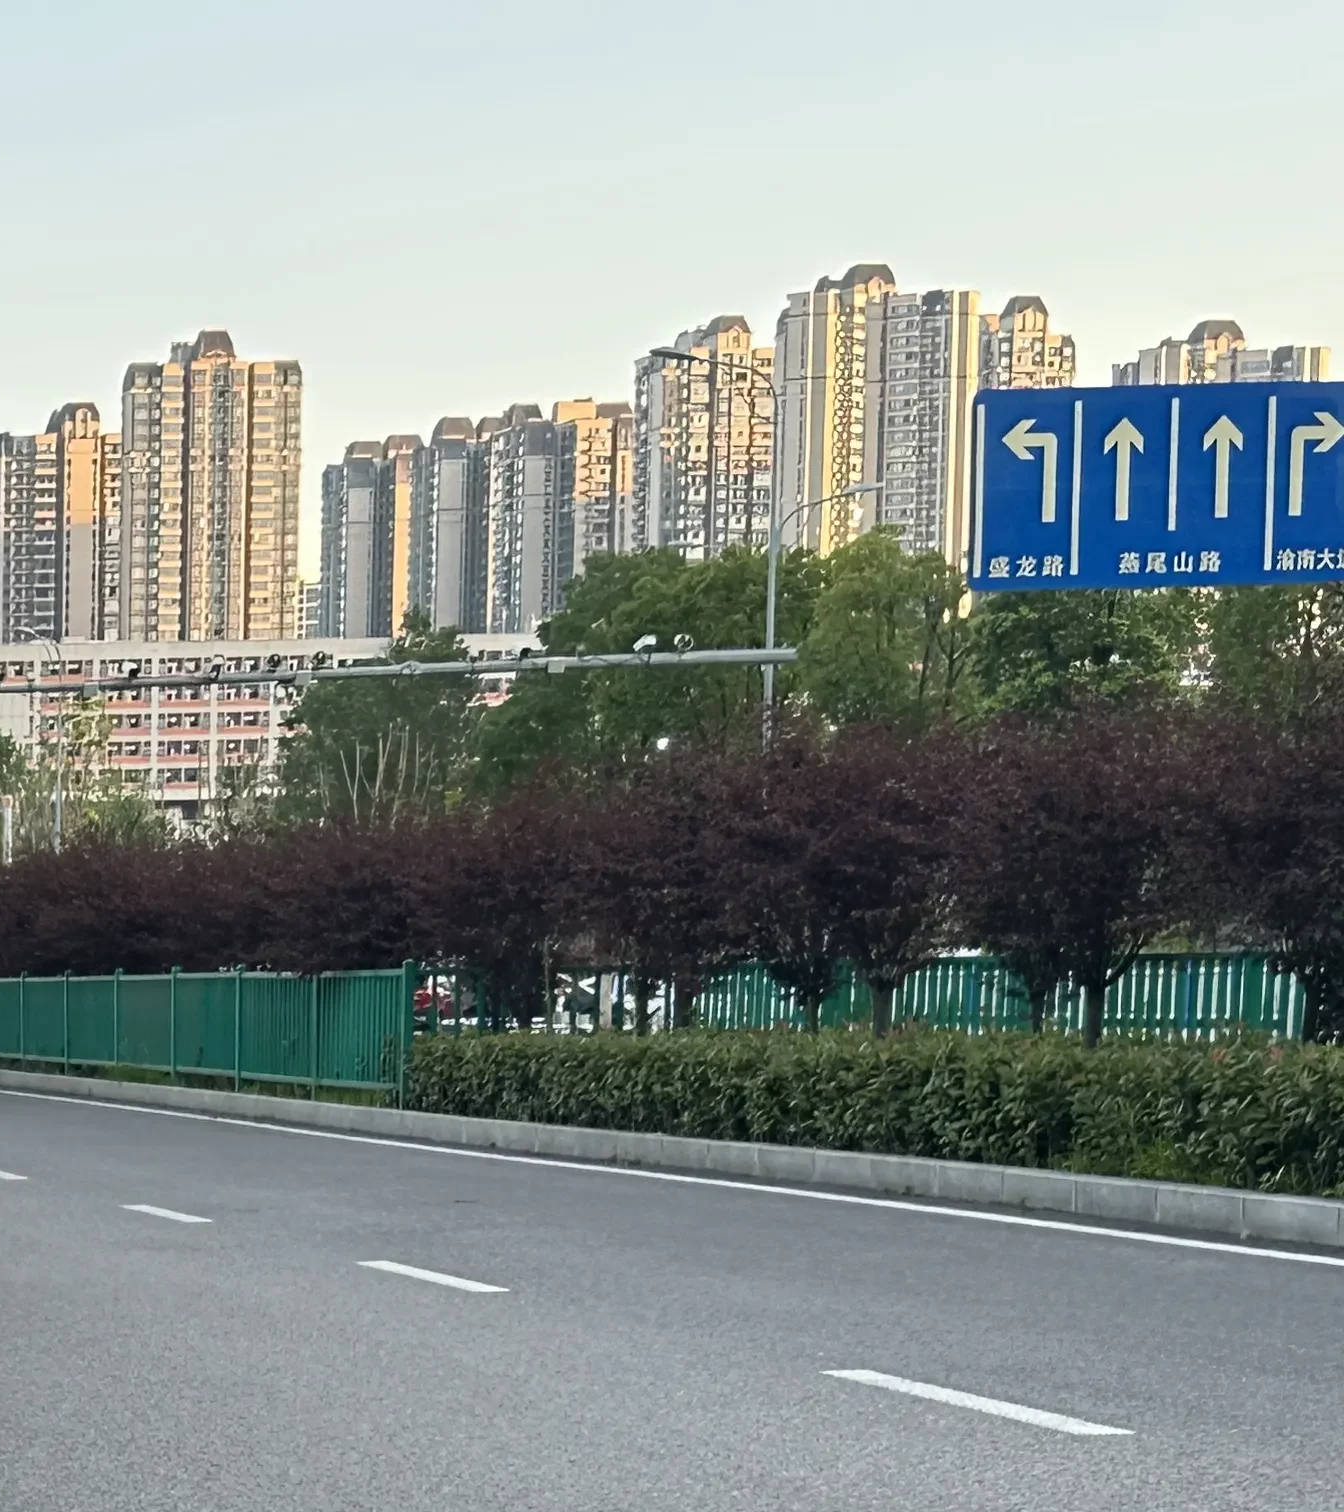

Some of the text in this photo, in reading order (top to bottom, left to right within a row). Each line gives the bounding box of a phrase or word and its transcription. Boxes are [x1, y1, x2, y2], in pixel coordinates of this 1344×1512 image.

[988, 554, 1064, 578] 盛龙路
[1118, 550, 1221, 574] 燕尾山路
